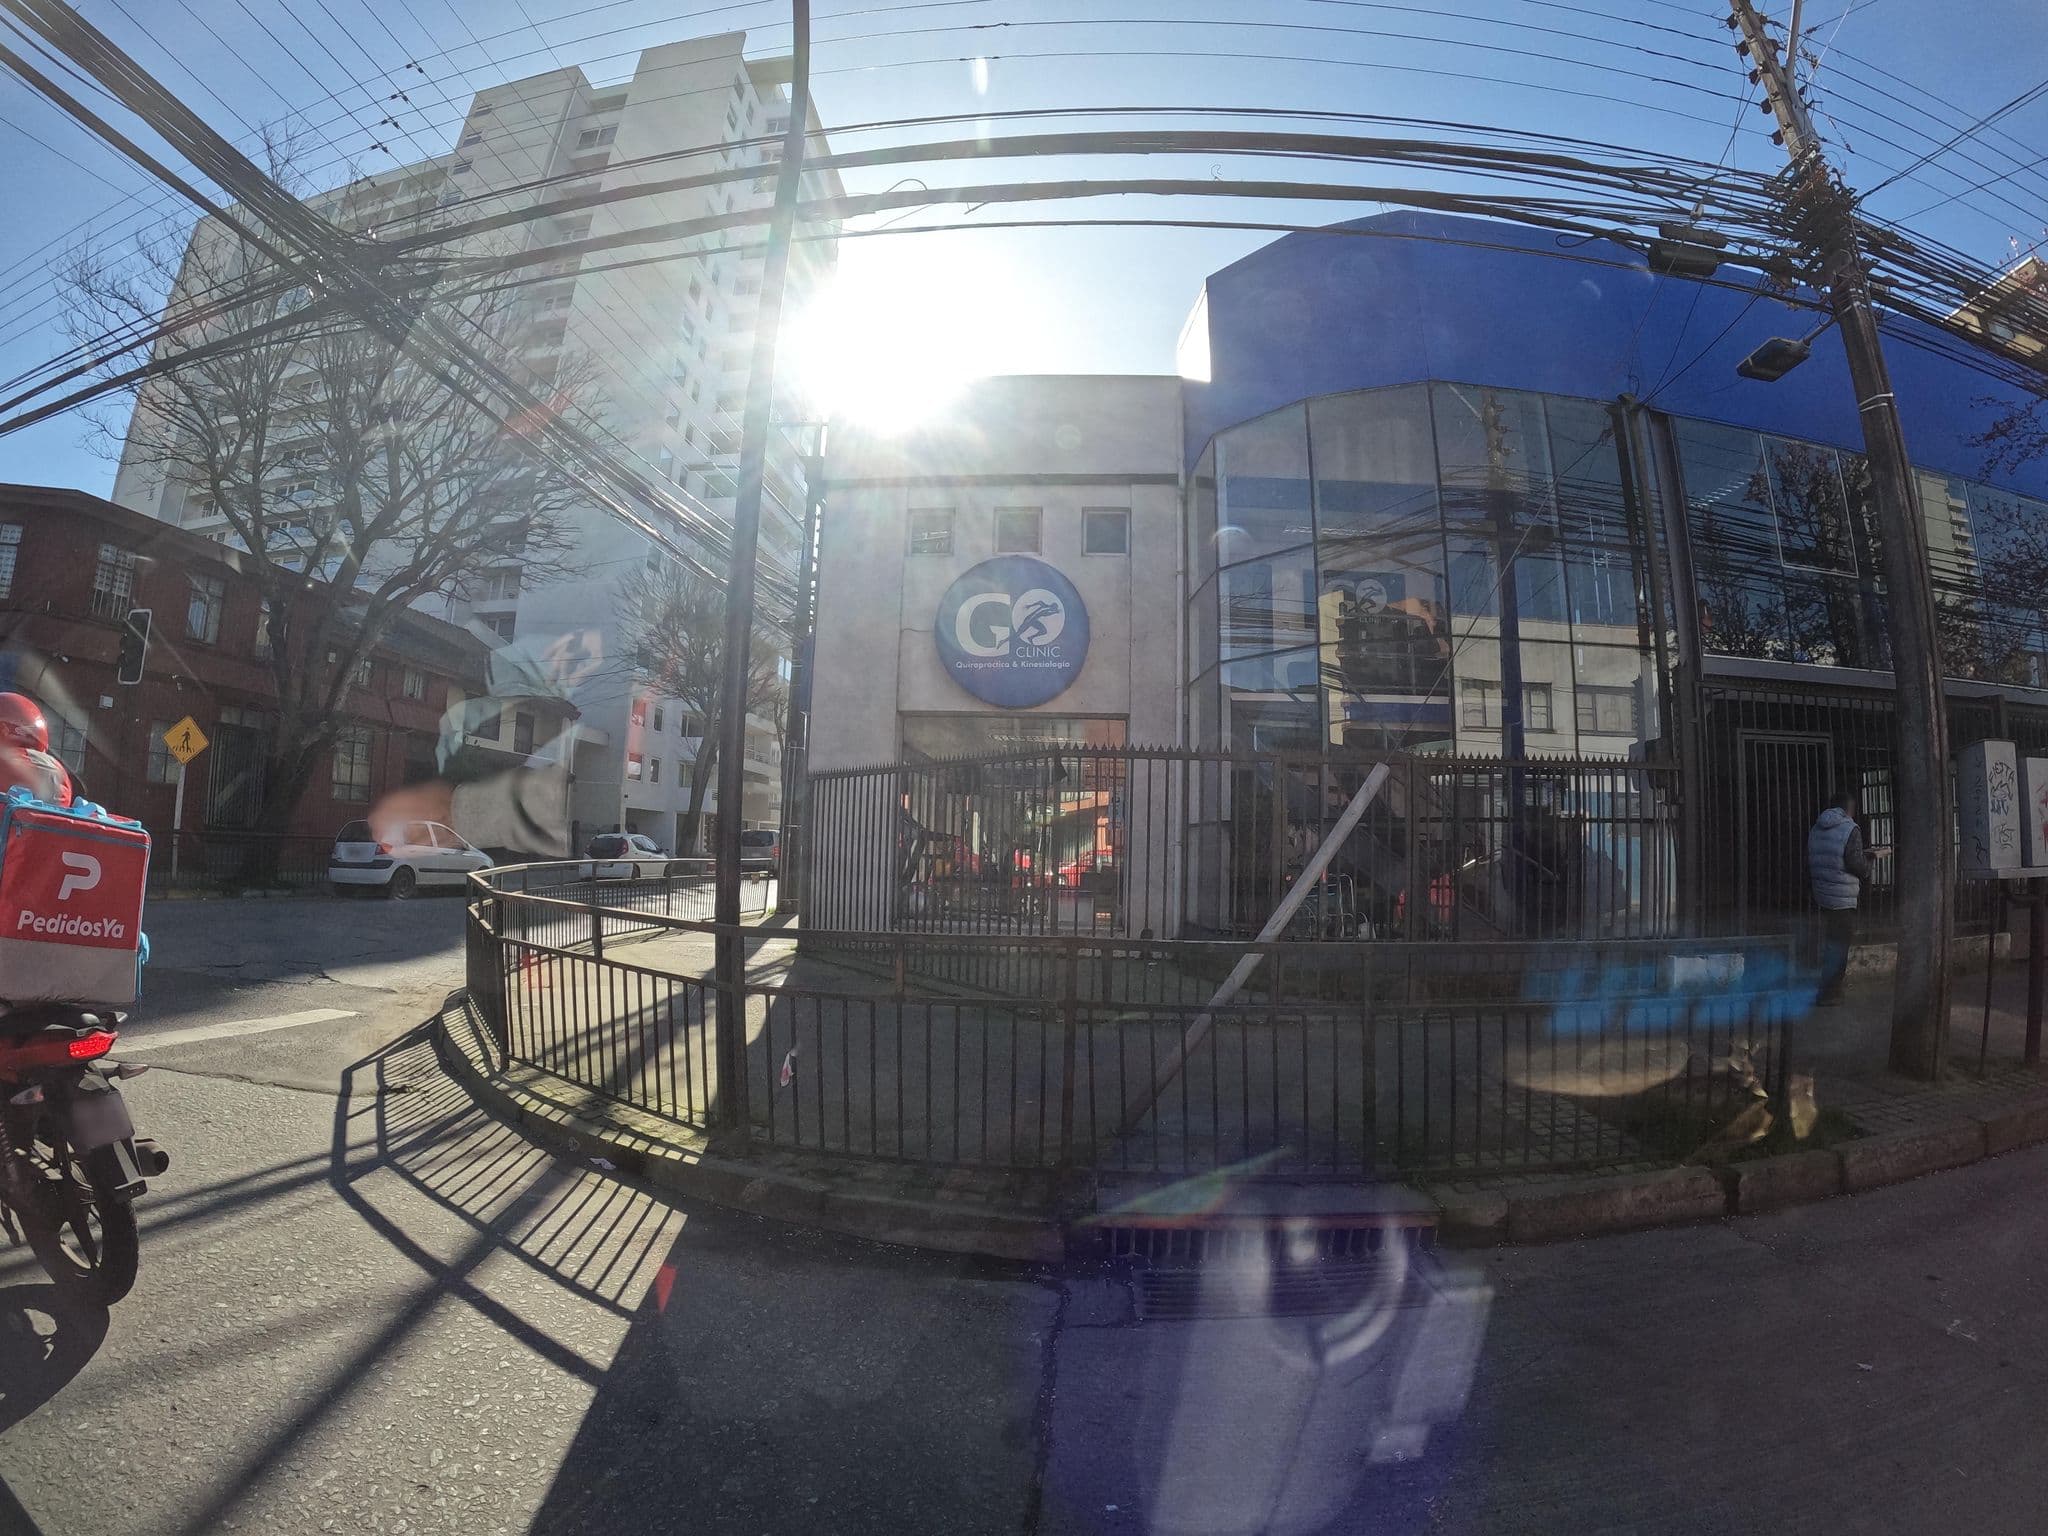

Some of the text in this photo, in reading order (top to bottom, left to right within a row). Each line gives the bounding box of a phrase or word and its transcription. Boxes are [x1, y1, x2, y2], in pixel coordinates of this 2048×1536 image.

[956, 588, 1066, 657] GO
[1016, 646, 1061, 658] CLINIC
[17, 909, 125, 938] PedidosYa
